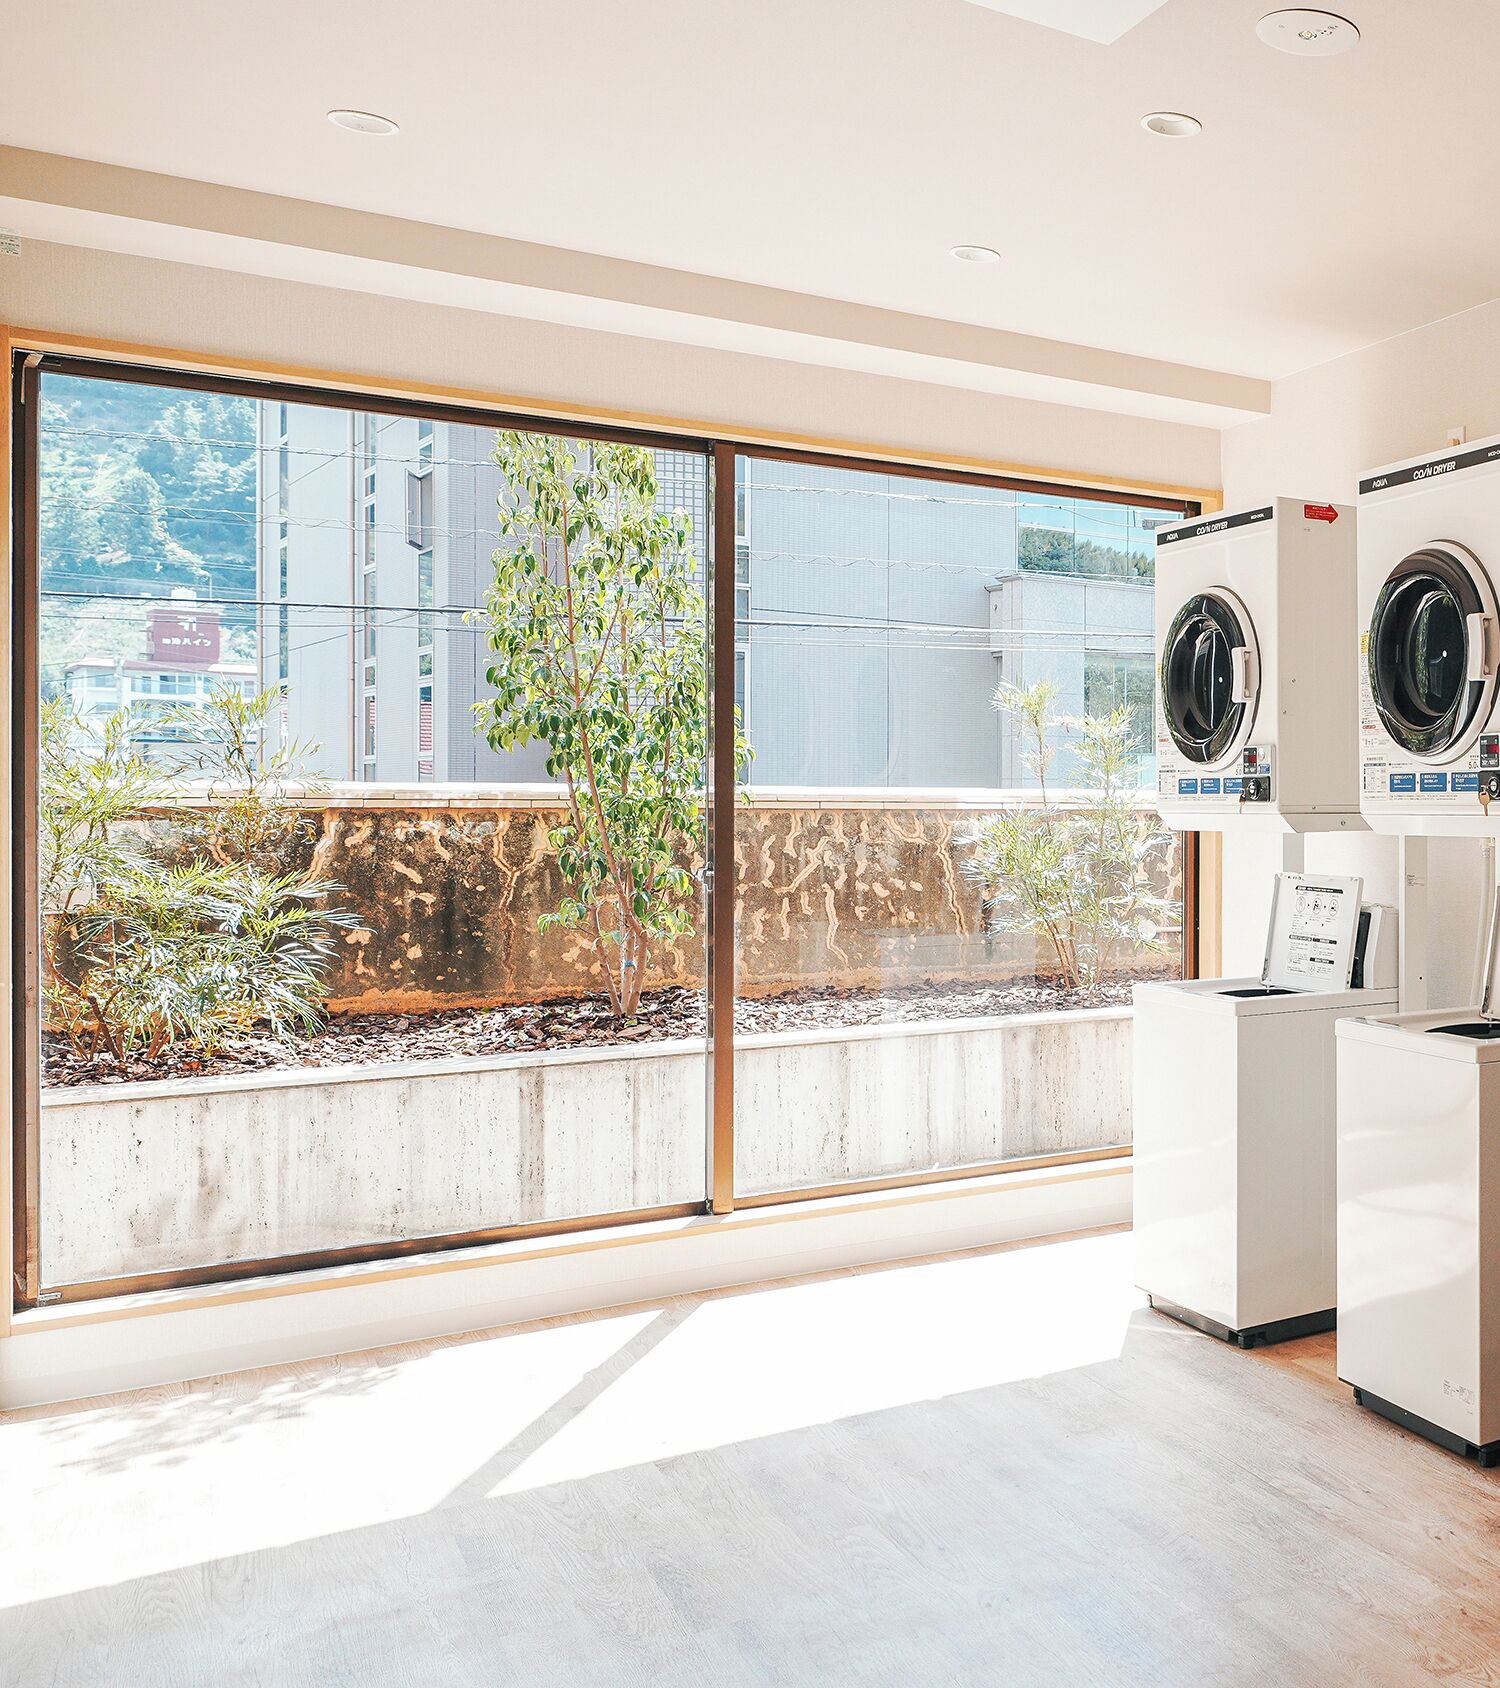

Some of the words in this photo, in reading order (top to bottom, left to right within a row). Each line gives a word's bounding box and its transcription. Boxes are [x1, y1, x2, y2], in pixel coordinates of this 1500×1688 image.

[1433, 461, 1456, 475] DRYER
[1371, 478, 1388, 488] AQUA
[1211, 520, 1229, 532] DRYER
[1166, 532, 1179, 541] AQUA
